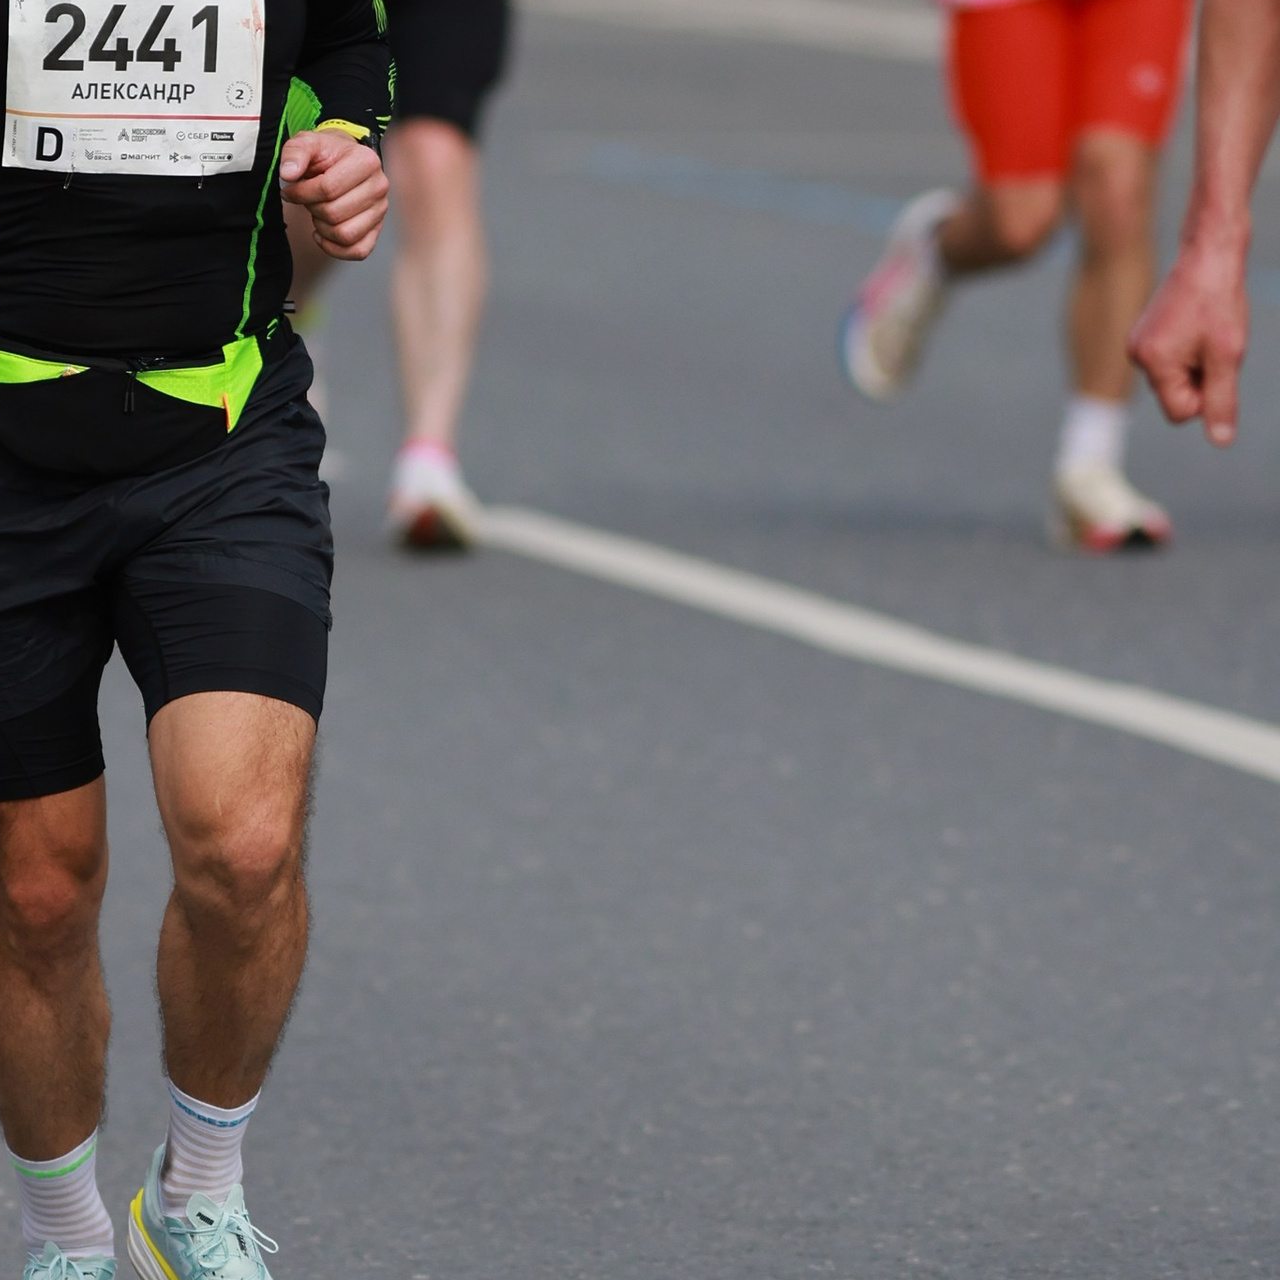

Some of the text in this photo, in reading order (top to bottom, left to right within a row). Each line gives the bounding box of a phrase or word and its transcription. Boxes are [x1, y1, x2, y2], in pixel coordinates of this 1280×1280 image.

[42, 2, 219, 73] 2441
[71, 83, 196, 104] АЛЕКСАНДР
[235, 89, 244, 100] 2
[35, 126, 64, 162] D
[187, 132, 209, 140] СБЕР
